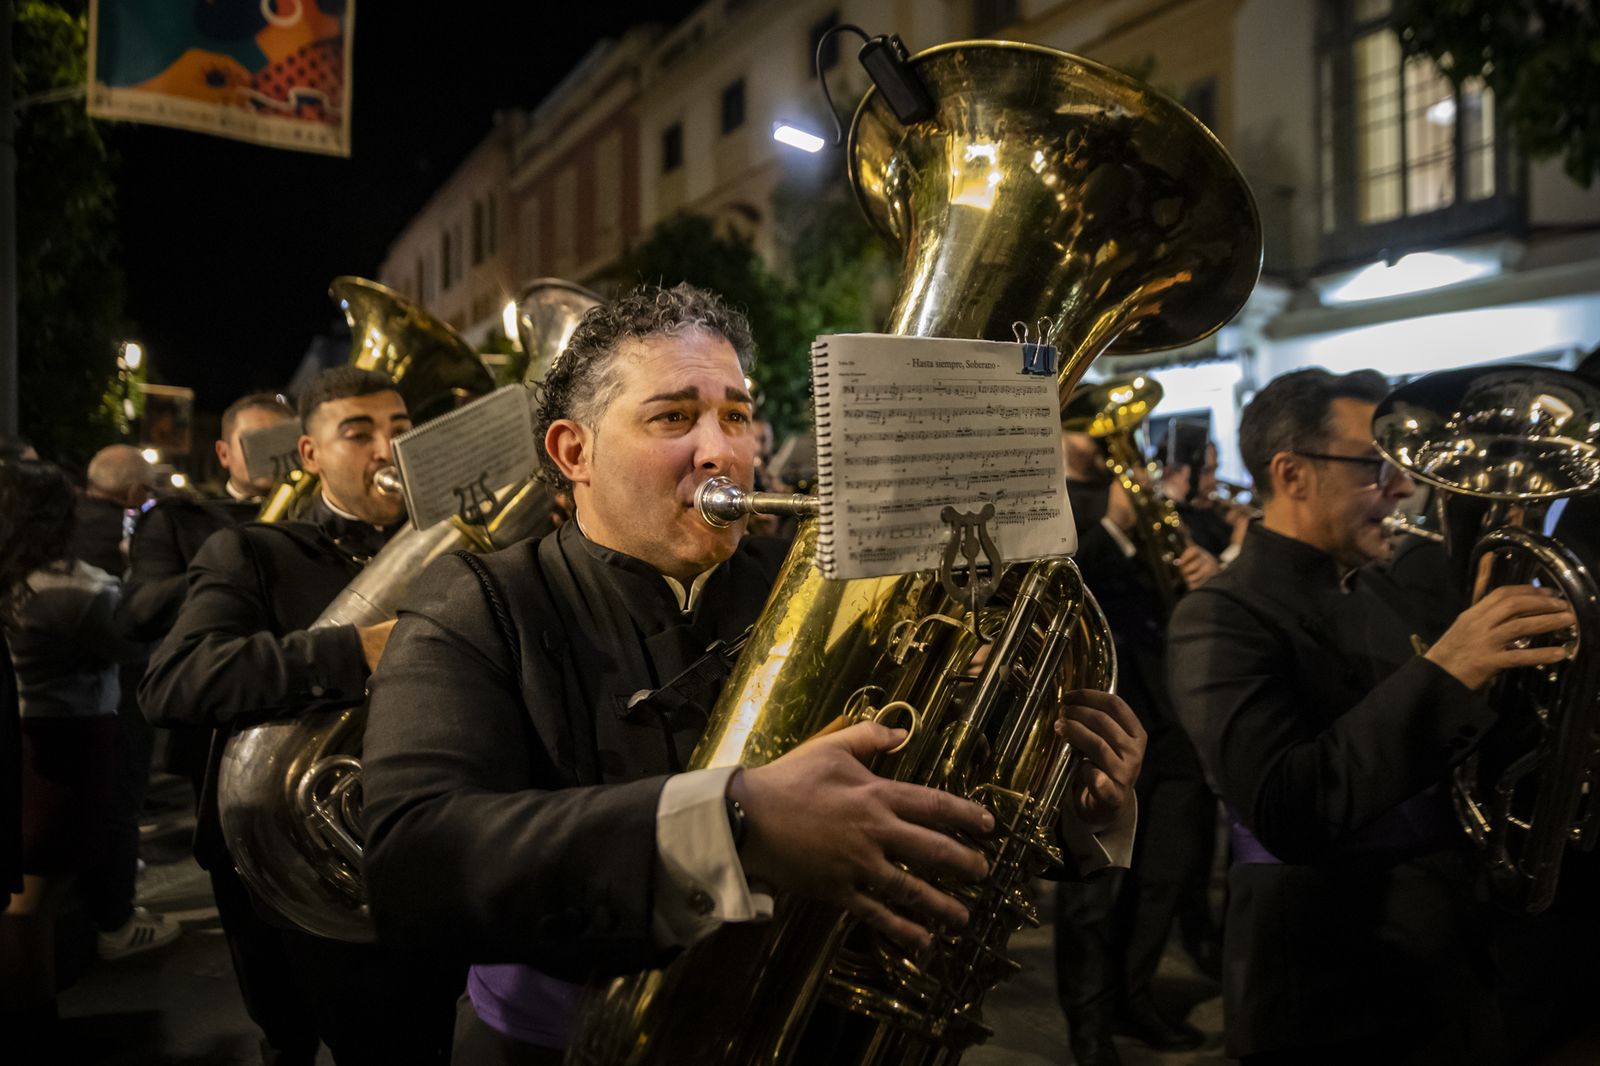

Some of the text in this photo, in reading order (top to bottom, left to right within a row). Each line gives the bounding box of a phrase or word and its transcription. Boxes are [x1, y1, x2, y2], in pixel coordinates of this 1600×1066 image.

[912, 358, 934, 368] Hasta
[935, 359, 965, 370] siempre,
[965, 359, 996, 369] Soberano
